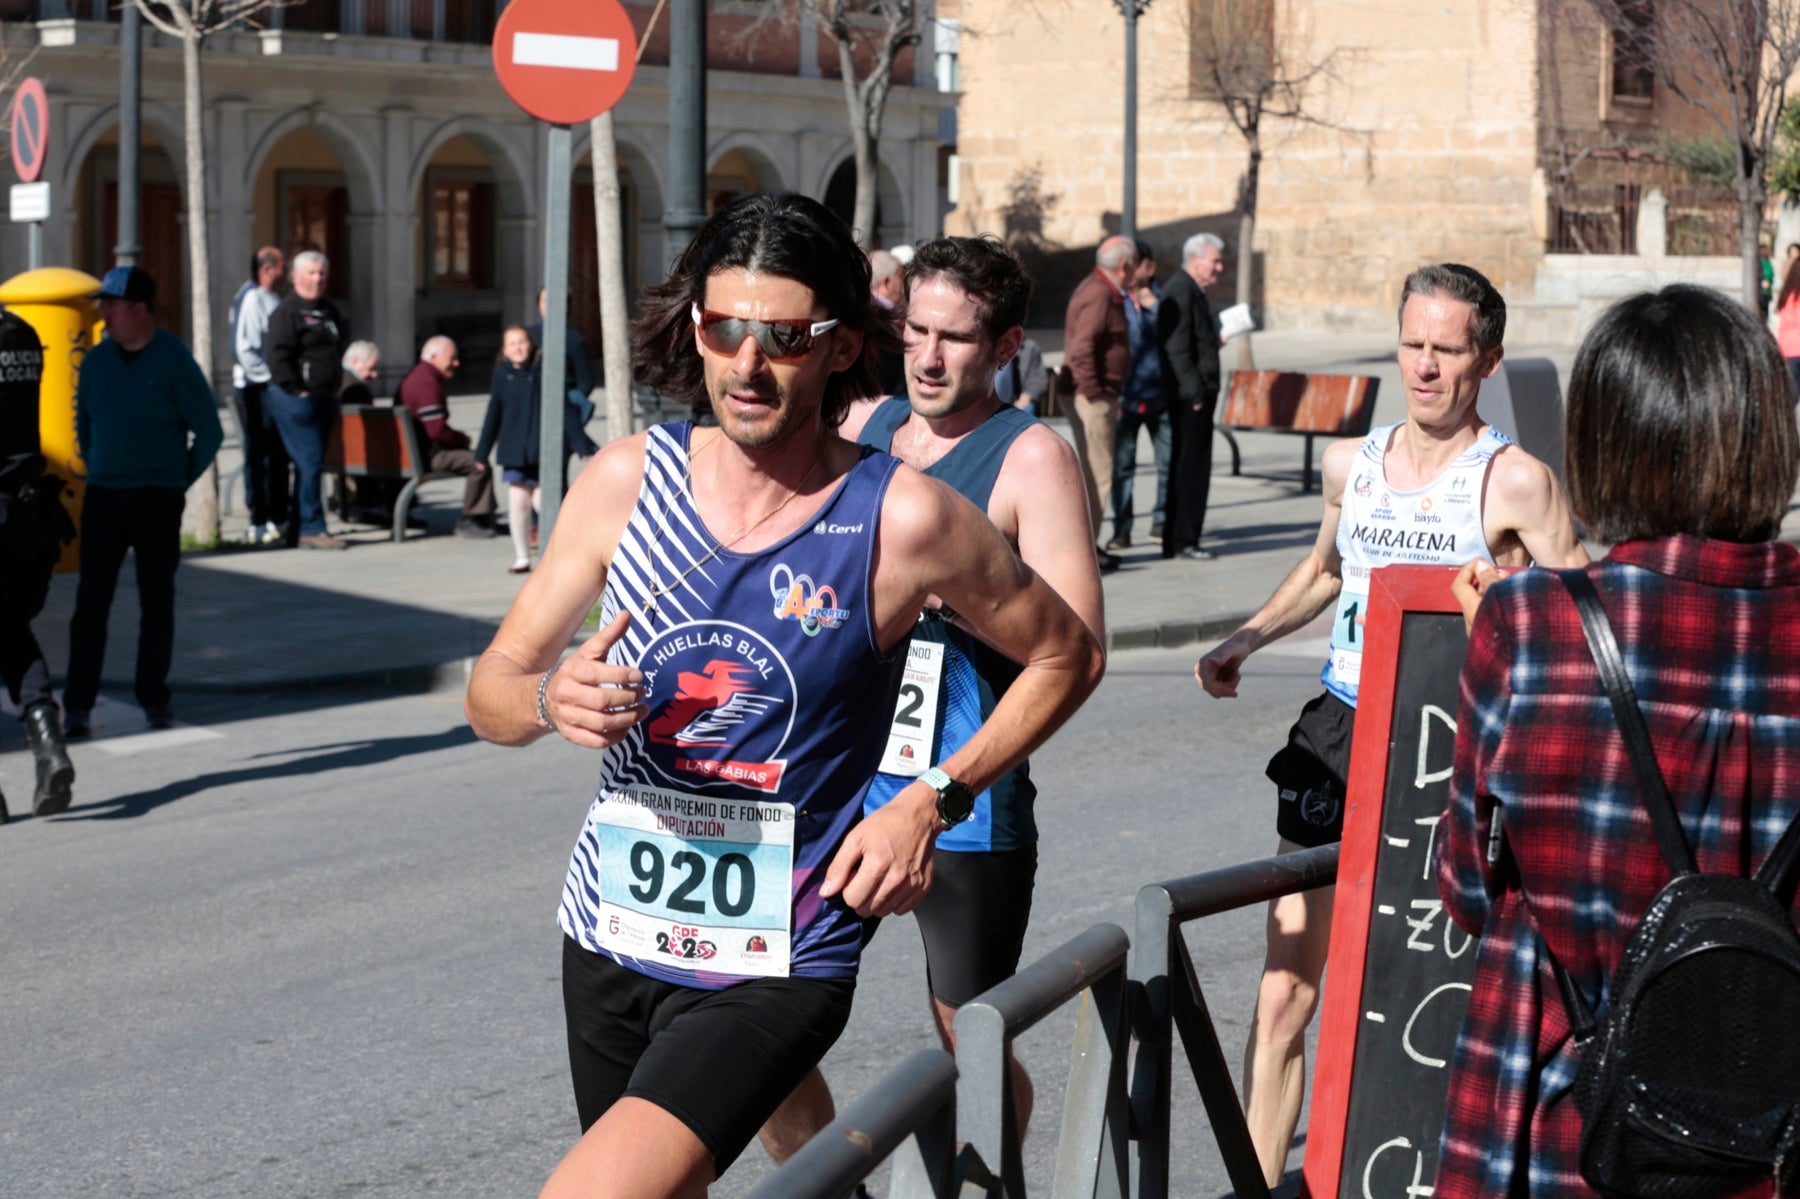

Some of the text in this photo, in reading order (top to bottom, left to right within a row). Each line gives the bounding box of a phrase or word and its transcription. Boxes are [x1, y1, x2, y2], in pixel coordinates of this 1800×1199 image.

[828, 522, 864, 534] Cervi
[1351, 523, 1456, 552] MARACENA
[1362, 547, 1441, 562] CLUB DE ATLETISMO
[653, 631, 733, 664] HUELLAS
[736, 642, 776, 680] BLAL
[907, 645, 931, 659] ONDO
[894, 683, 925, 728] 2
[1414, 704, 1457, 788] D
[686, 759, 767, 784] LAS GABIAS
[641, 791, 673, 811] GRAN
[674, 799, 717, 819] PREMIO
[720, 804, 735, 821] DE
[740, 806, 782, 823] FONDO
[657, 814, 726, 837] DIPUTACIÓN
[629, 840, 756, 918] 920
[1406, 899, 1480, 960] ZU
